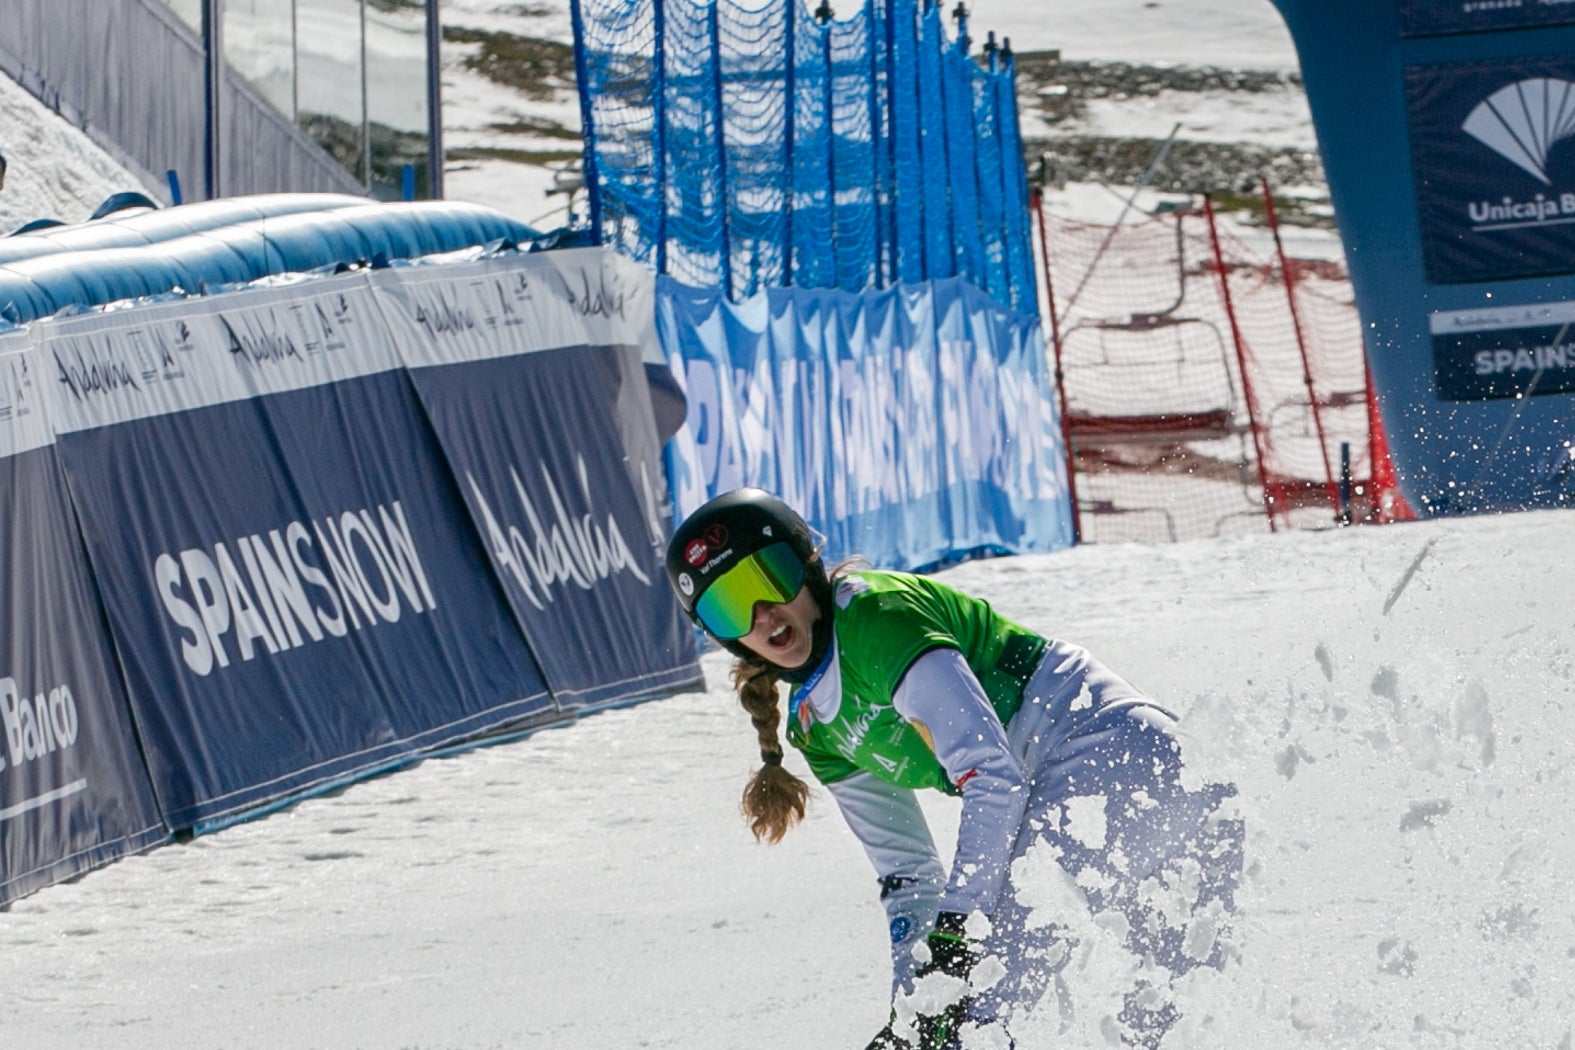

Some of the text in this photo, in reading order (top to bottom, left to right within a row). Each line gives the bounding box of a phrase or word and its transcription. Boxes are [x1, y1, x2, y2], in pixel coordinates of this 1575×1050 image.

[1468, 194, 1559, 222] Unicaja
[155, 501, 436, 676] SPAINSNOW
[0, 676, 79, 767] Banco
